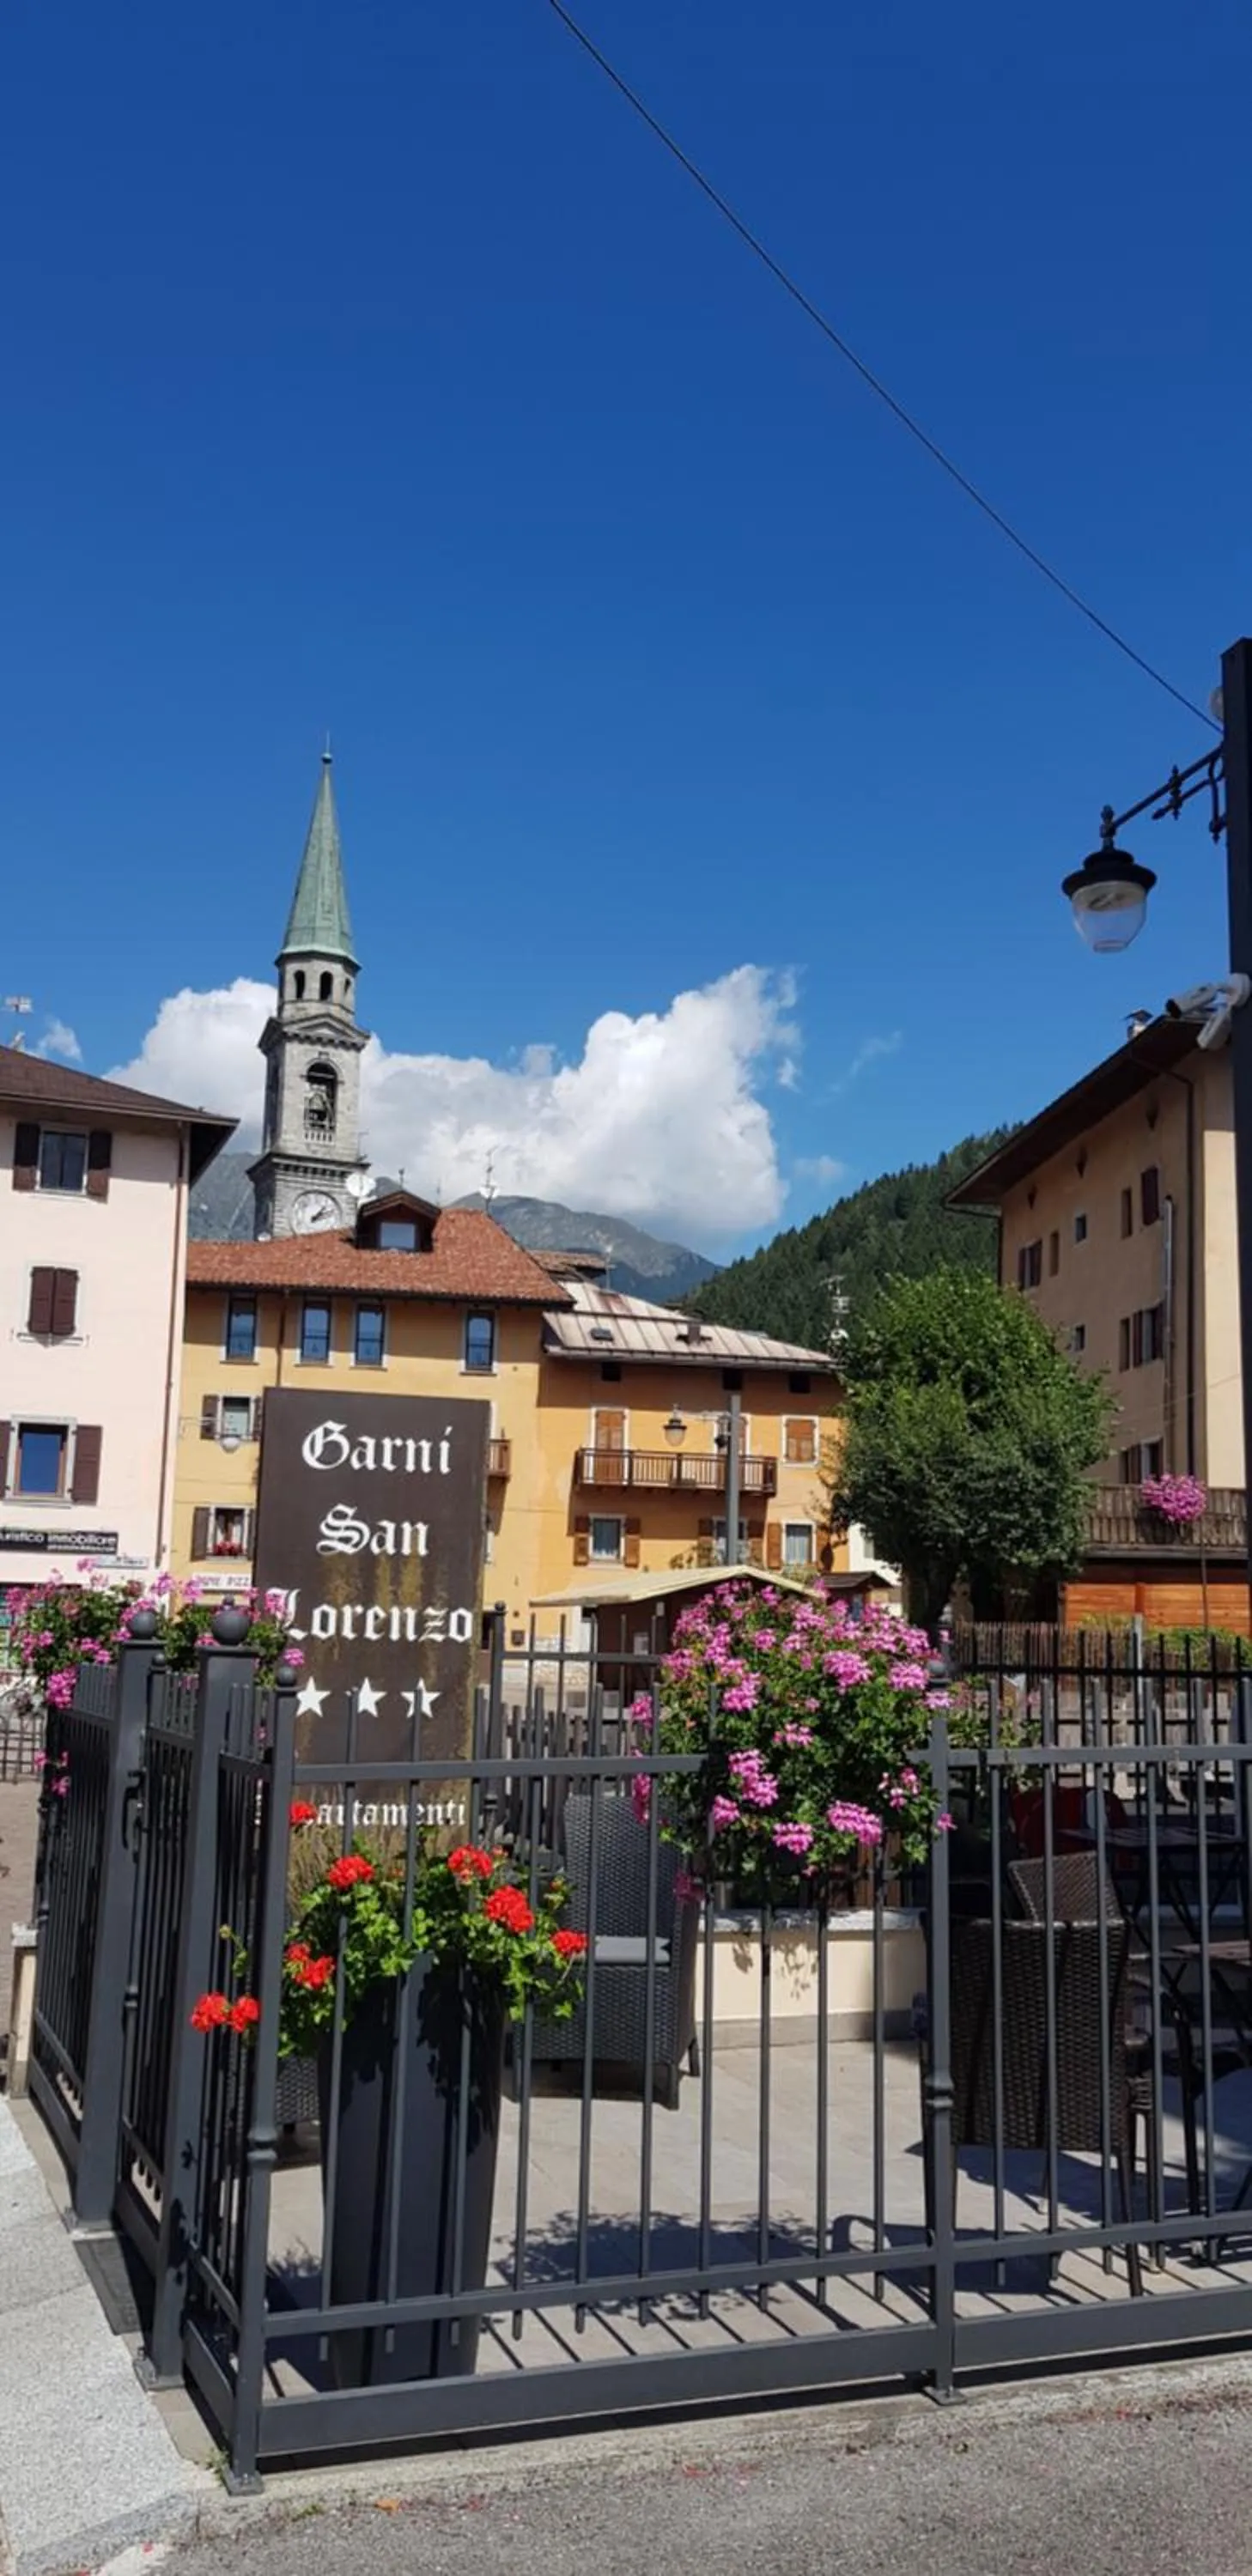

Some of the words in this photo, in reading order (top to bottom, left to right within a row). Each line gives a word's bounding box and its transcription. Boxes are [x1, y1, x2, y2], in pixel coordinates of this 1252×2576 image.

[301, 1419, 453, 1474] Garni
[315, 1503, 428, 1556] San
[264, 1587, 472, 1642] Lorenzo
